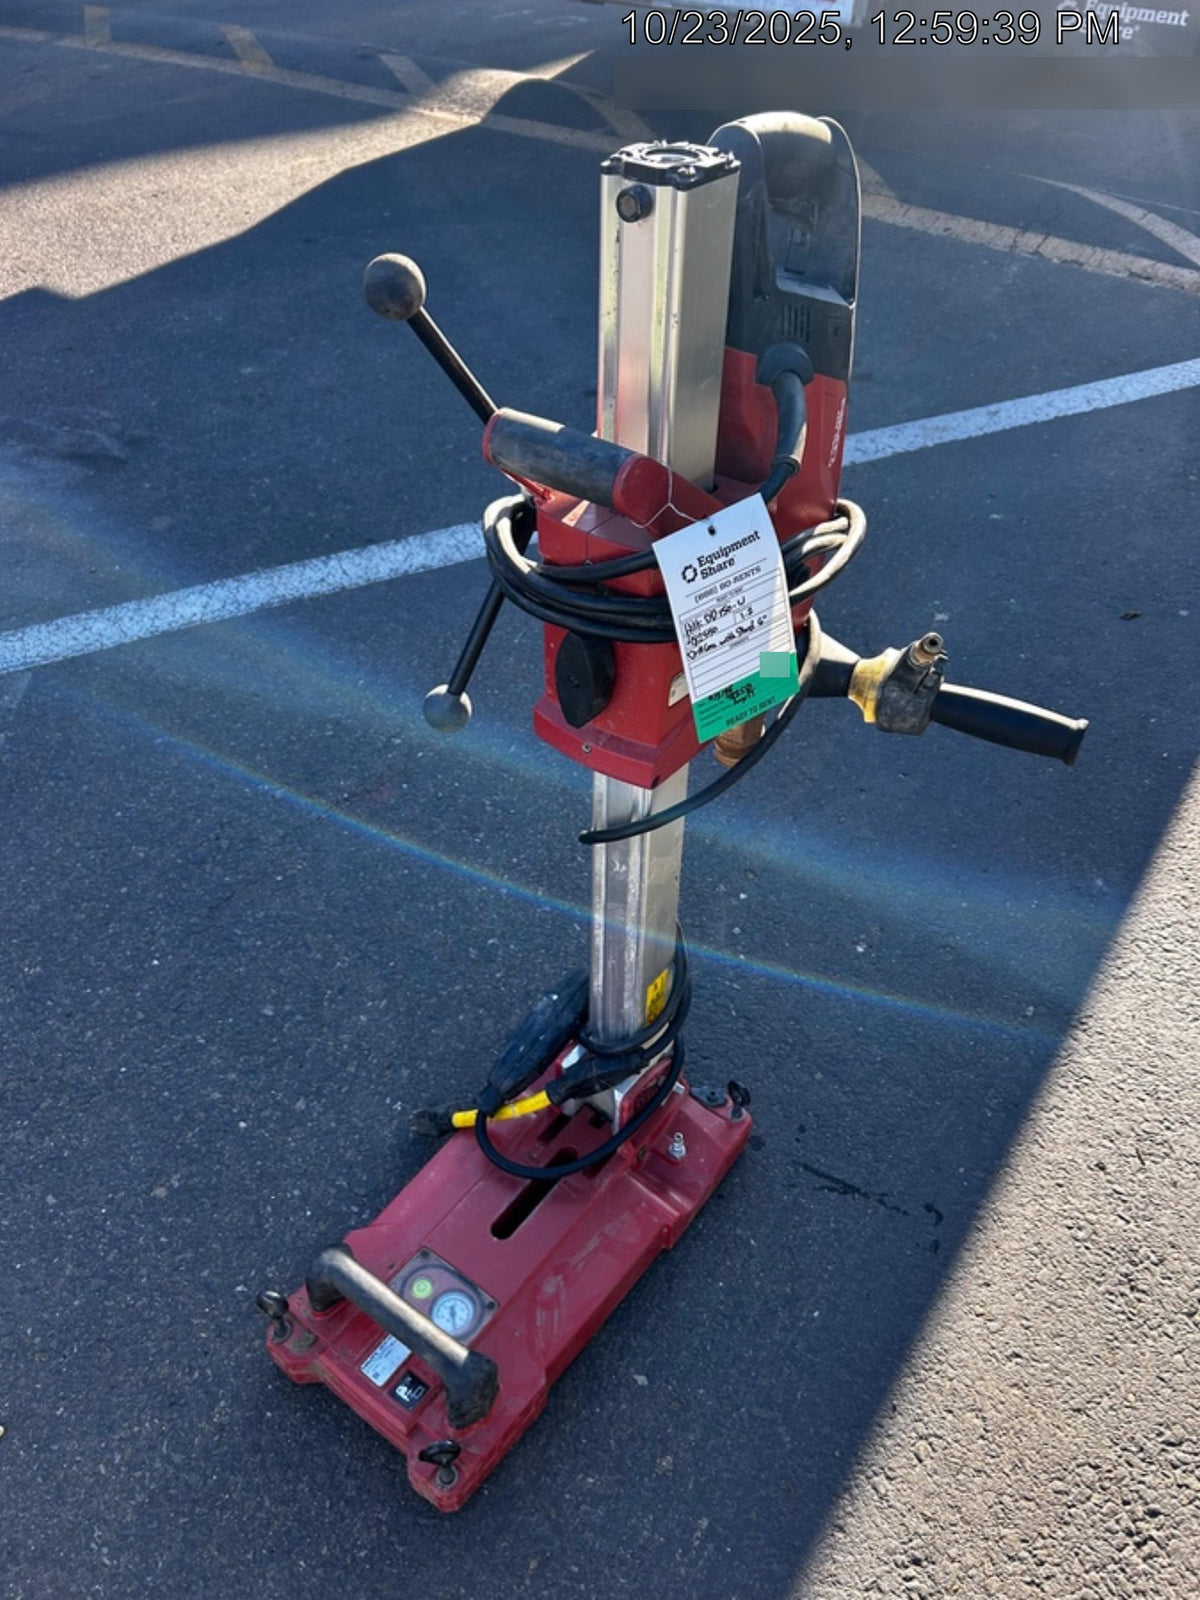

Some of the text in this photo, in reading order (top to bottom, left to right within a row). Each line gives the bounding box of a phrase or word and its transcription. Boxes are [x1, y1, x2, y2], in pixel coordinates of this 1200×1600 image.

[1083, 0, 1190, 26] Equipment
[696, 530, 761, 568] Equipment
[700, 557, 735, 580] Share
